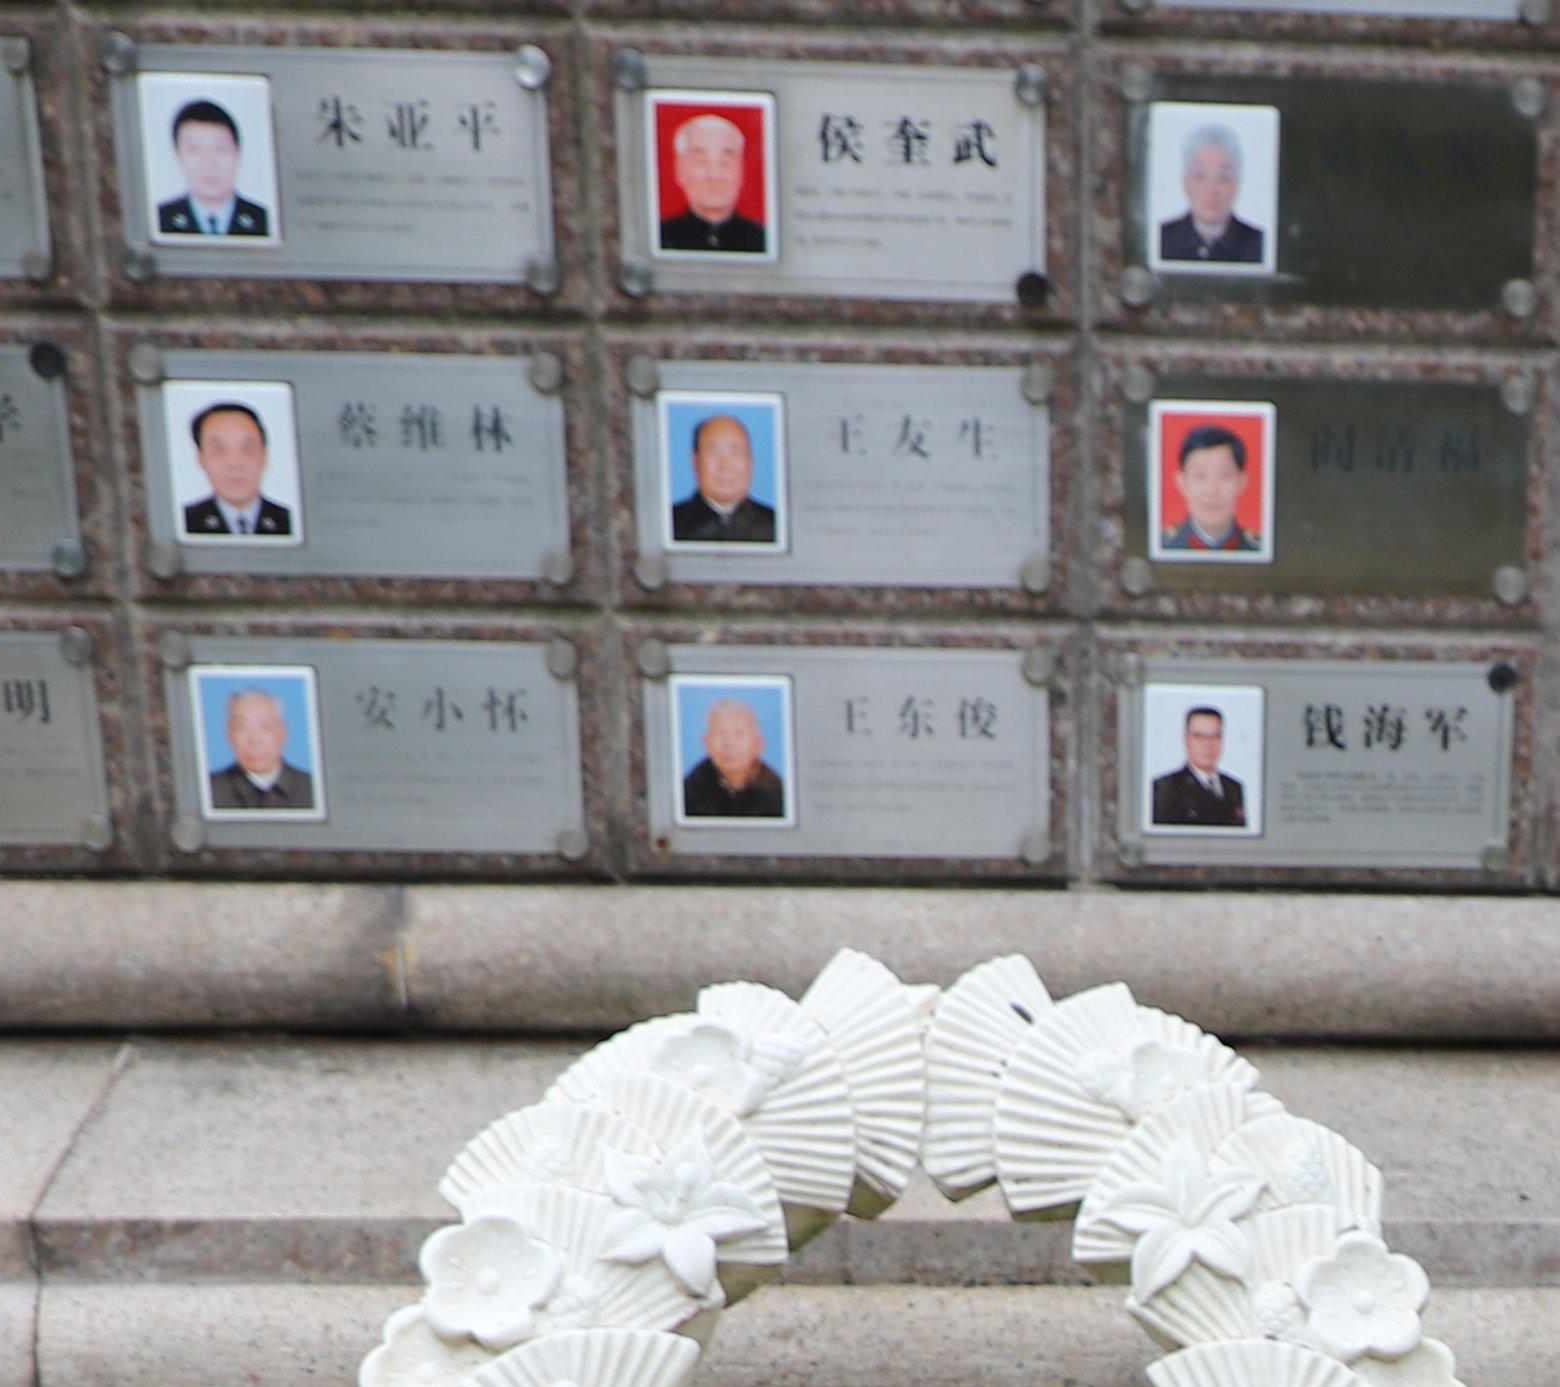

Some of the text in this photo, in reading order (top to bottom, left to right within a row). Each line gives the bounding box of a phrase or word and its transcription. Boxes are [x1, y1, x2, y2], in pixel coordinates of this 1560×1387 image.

[316, 95, 504, 152] 朱亚平
[815, 113, 999, 170] 侯奎武
[336, 401, 513, 453] 蔡维林
[826, 412, 999, 464] 王友生
[353, 683, 529, 734] 安小怀
[834, 692, 1001, 744] 王东俊
[1302, 703, 1468, 753] 钱海军
